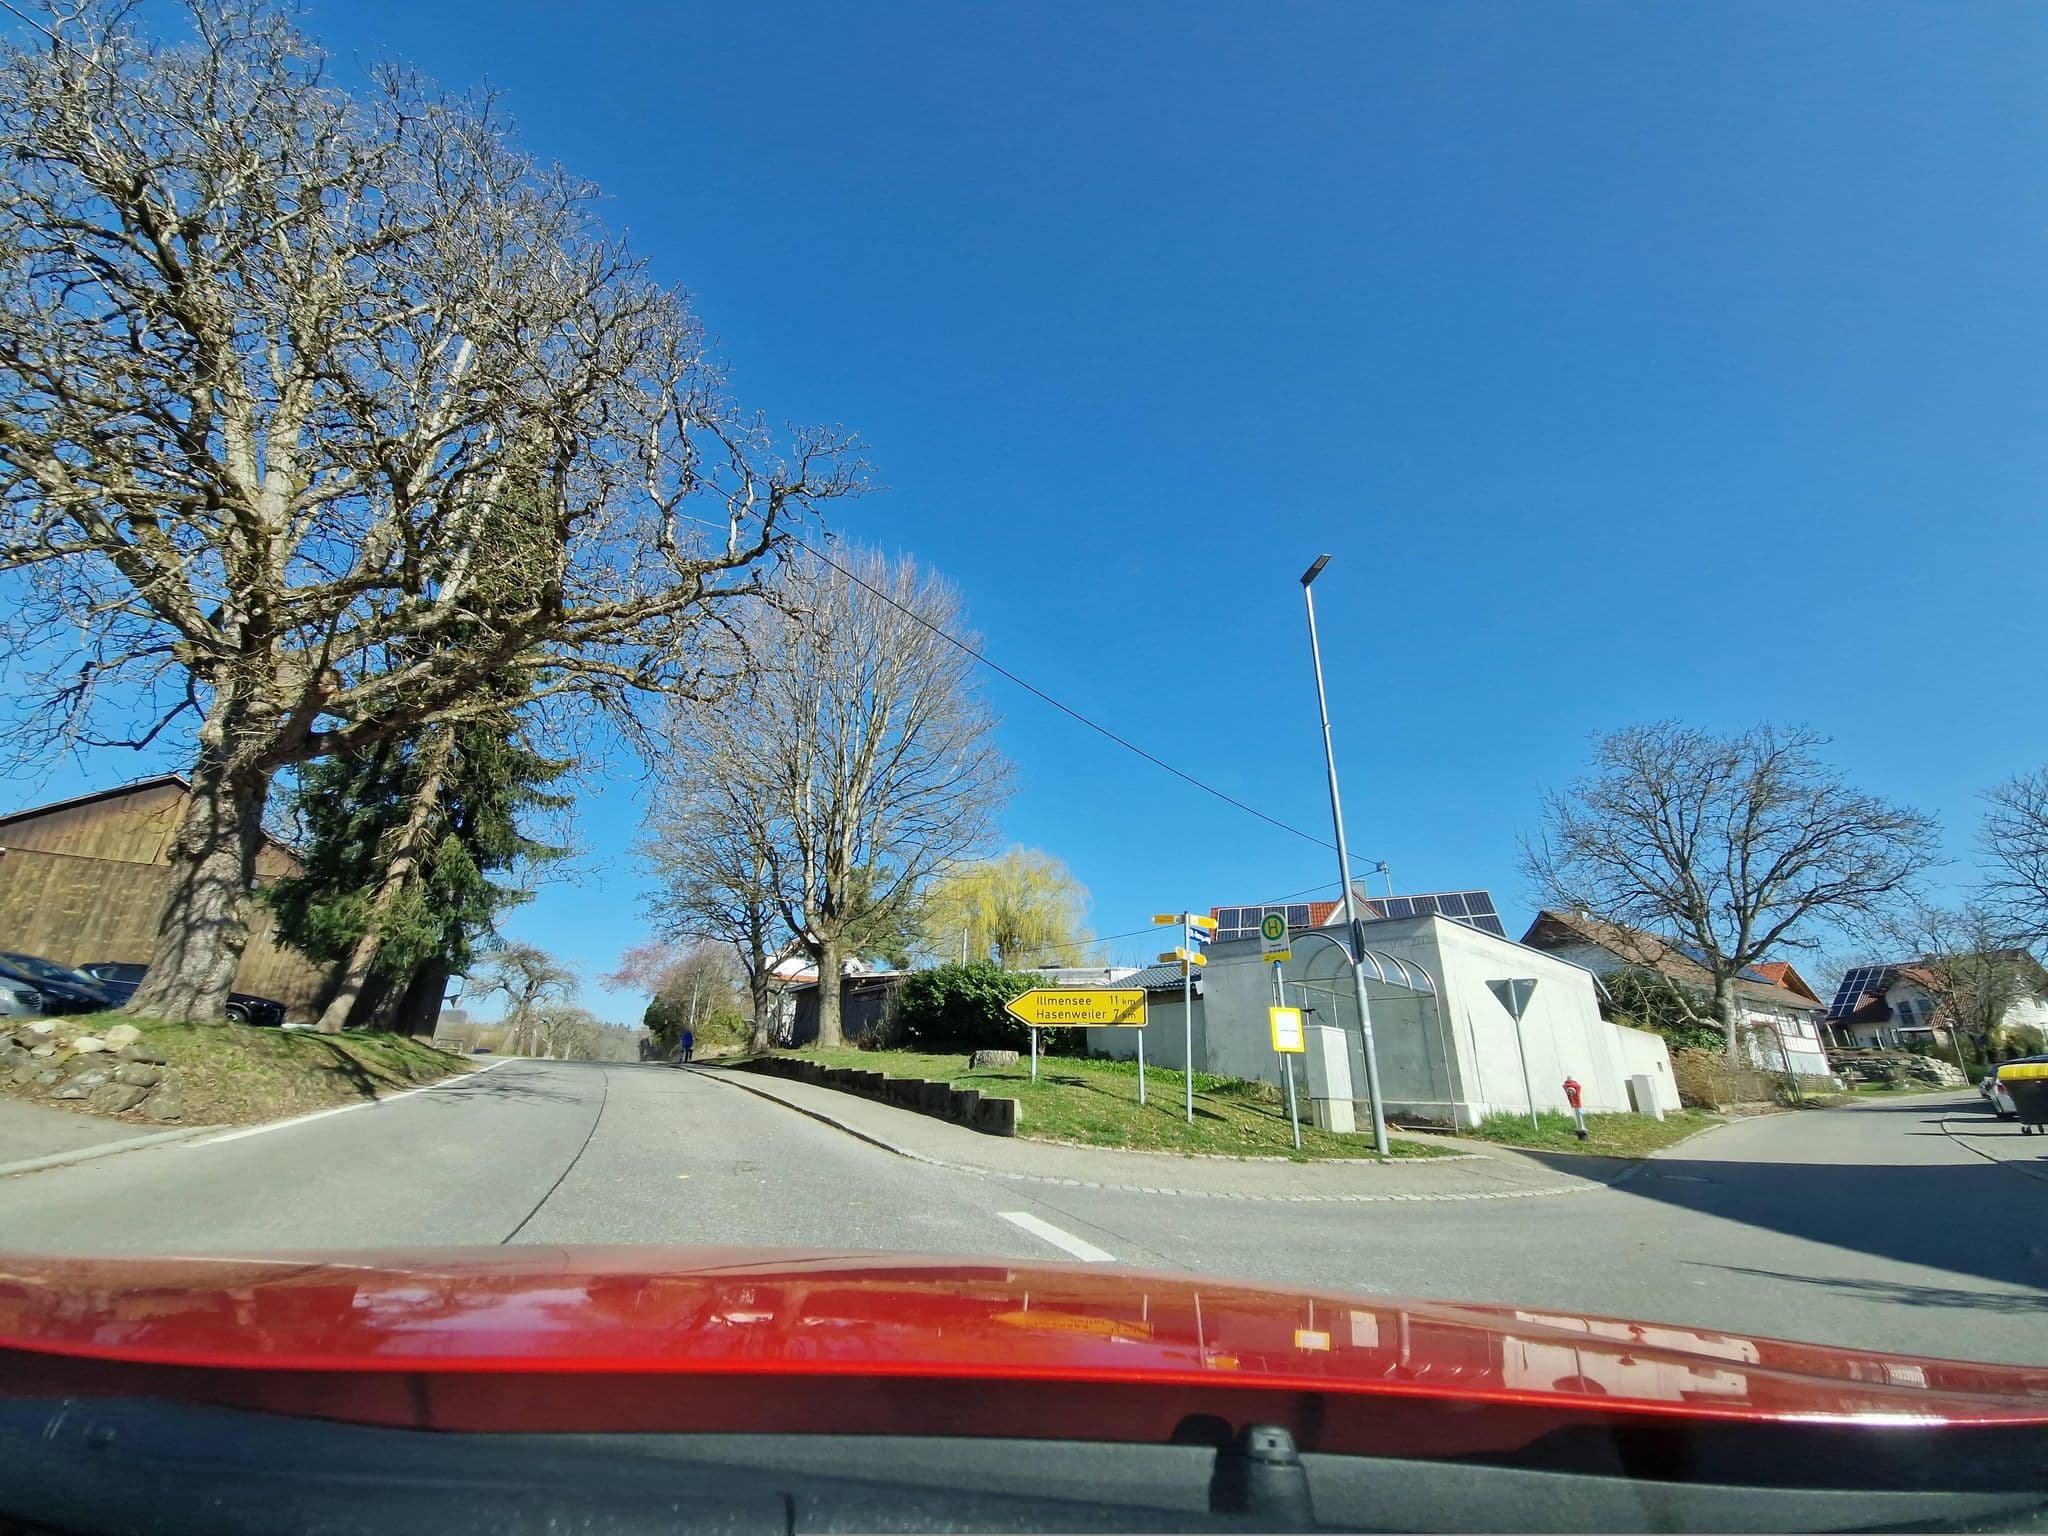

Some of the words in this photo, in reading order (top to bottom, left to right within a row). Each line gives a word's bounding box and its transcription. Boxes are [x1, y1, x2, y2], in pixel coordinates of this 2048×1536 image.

[1268, 920, 1279, 935] H
[1036, 996, 1092, 1006] Illmensee
[1110, 995, 1119, 1005] 11
[1122, 998, 1136, 1006] km
[1036, 1009, 1107, 1019] Hasenweiler
[1113, 1008, 1120, 1020] 7
[1122, 1011, 1136, 1019] km
